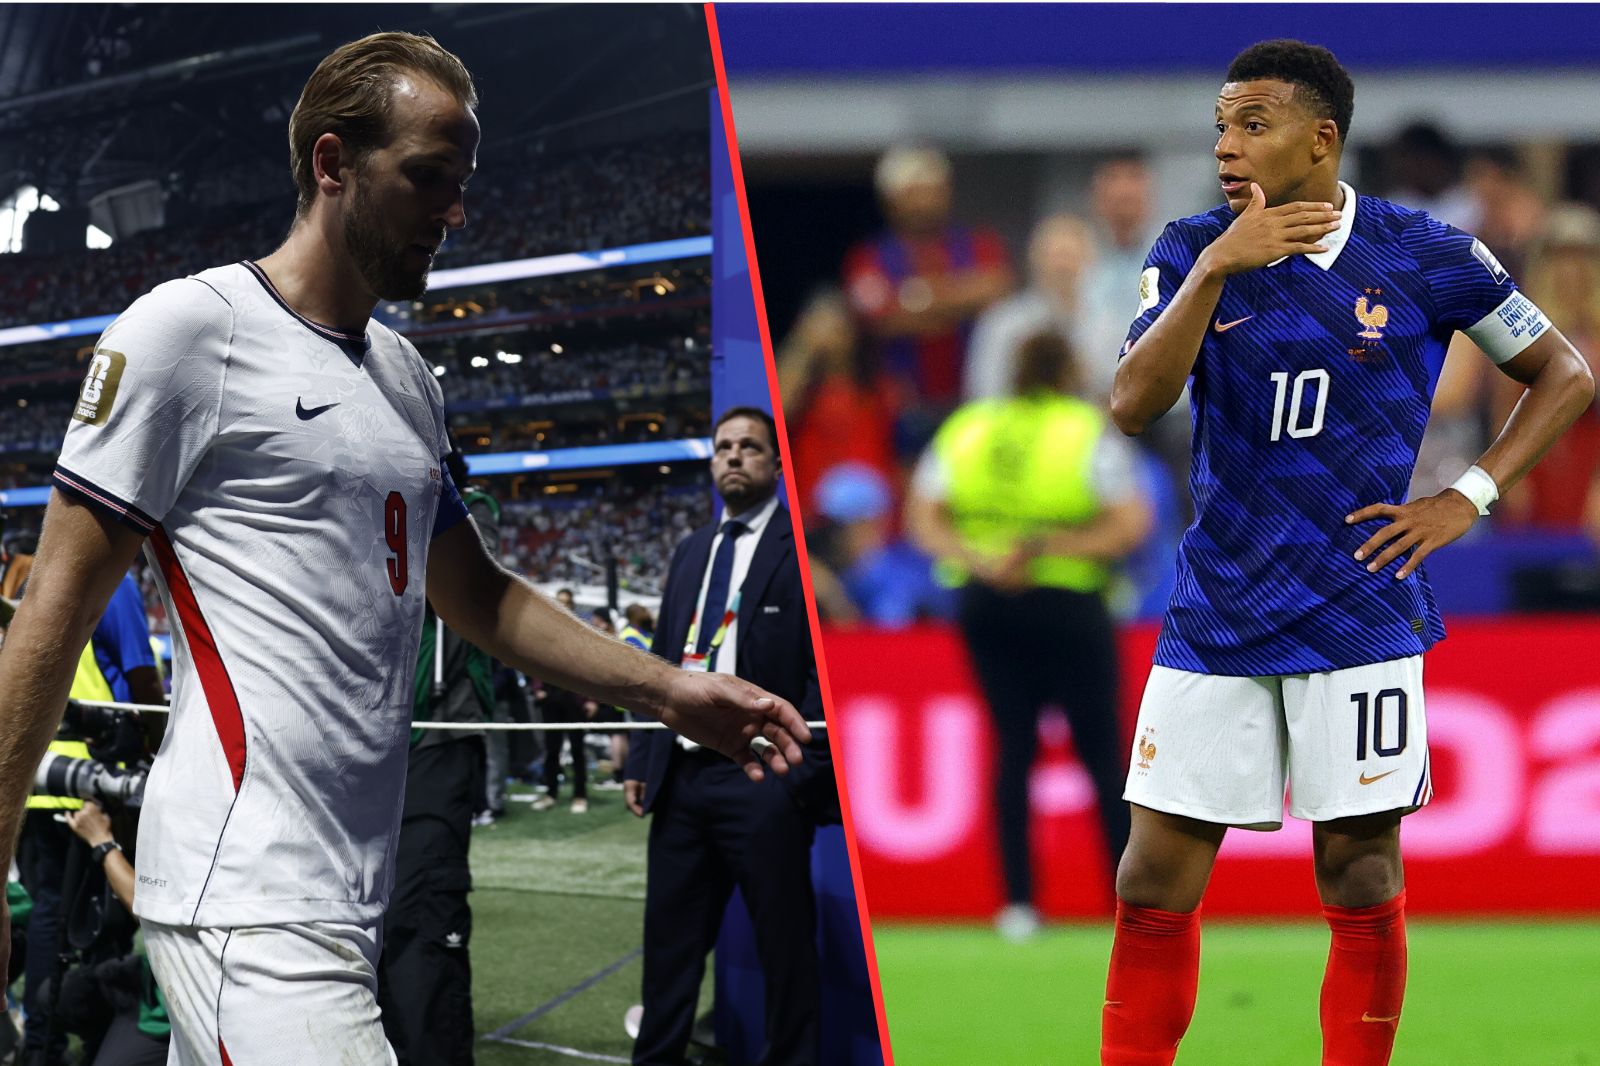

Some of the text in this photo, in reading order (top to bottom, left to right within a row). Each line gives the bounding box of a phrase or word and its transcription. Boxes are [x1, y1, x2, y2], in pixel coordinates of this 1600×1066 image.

[1270, 368, 1331, 442] 10
[384, 490, 409, 597] 9
[1350, 687, 1408, 762] 10
